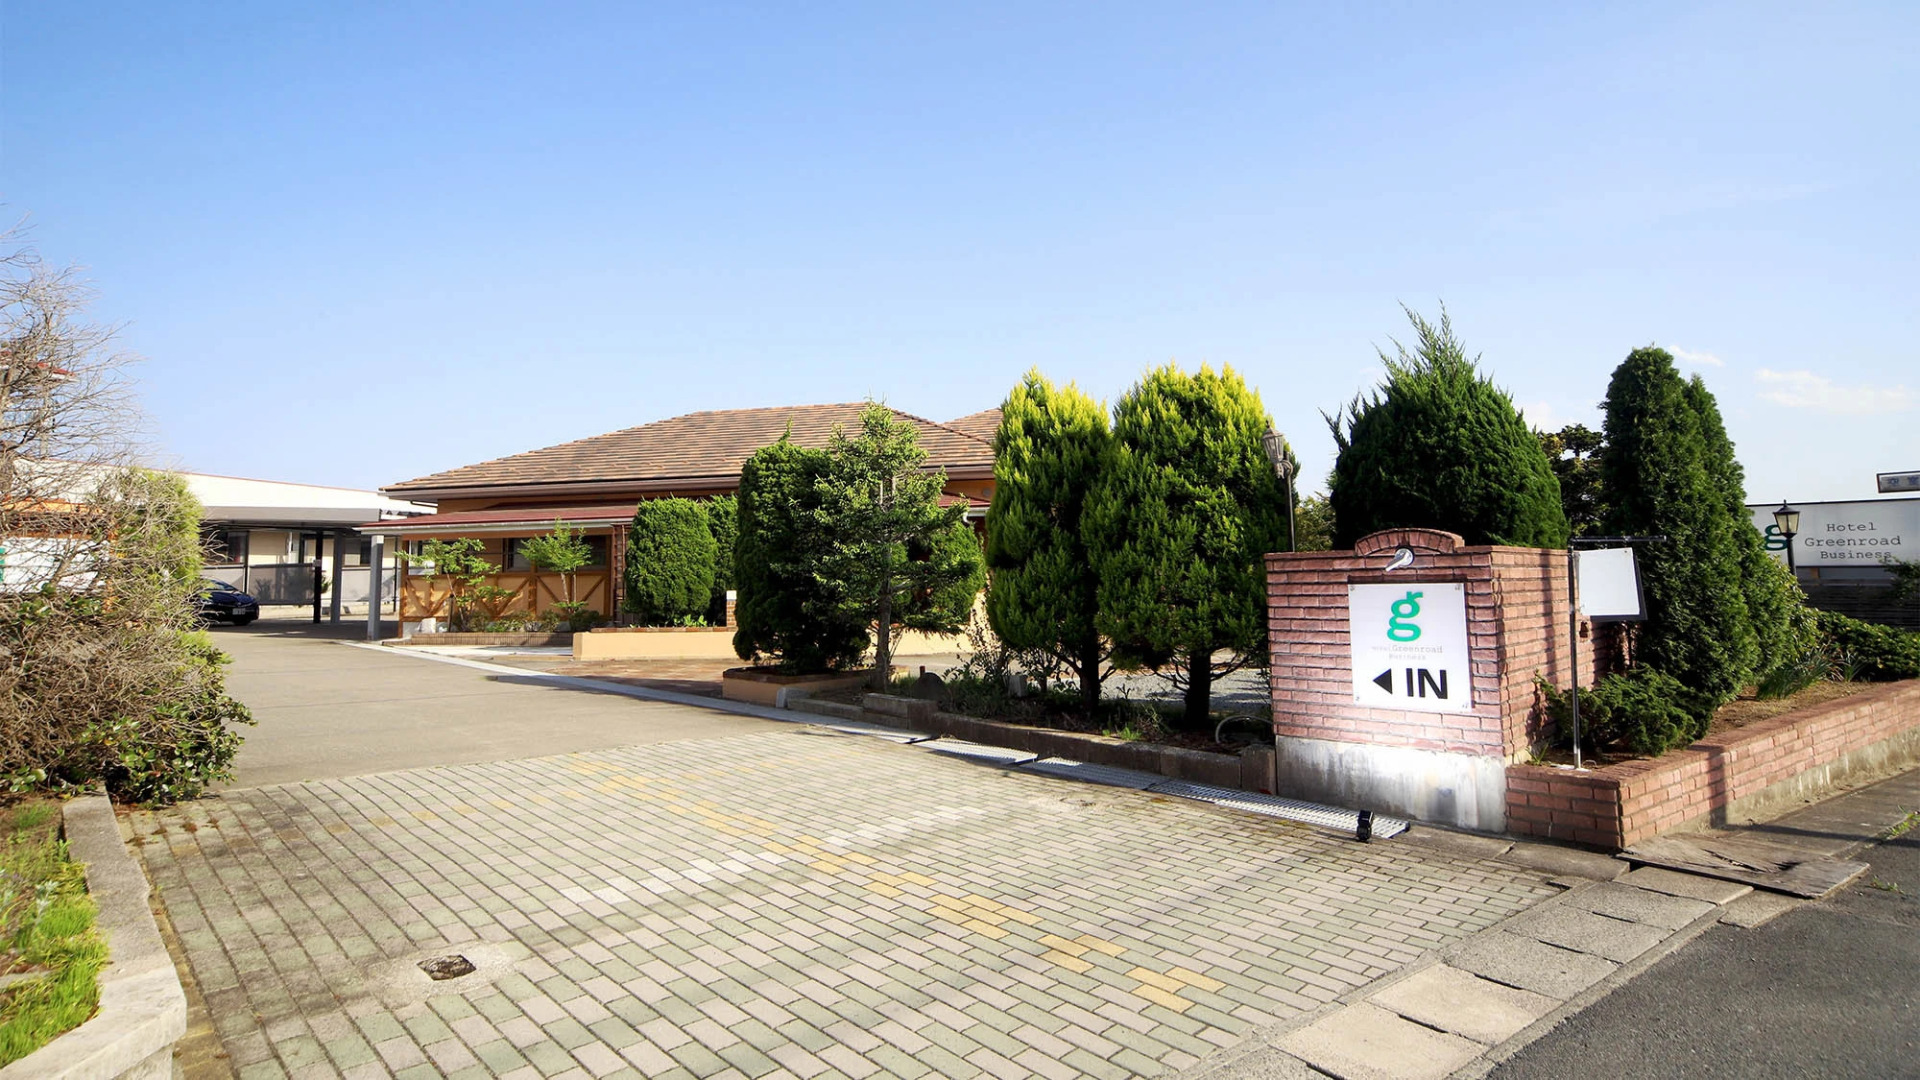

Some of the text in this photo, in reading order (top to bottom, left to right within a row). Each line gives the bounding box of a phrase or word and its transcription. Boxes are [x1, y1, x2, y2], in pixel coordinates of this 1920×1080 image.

[1826, 522, 1877, 532] Hotel
[1804, 535, 1901, 547] Greenroad
[1820, 550, 1893, 559] Business
[1391, 645, 1443, 654] Greenroad
[1406, 667, 1448, 700] IN
